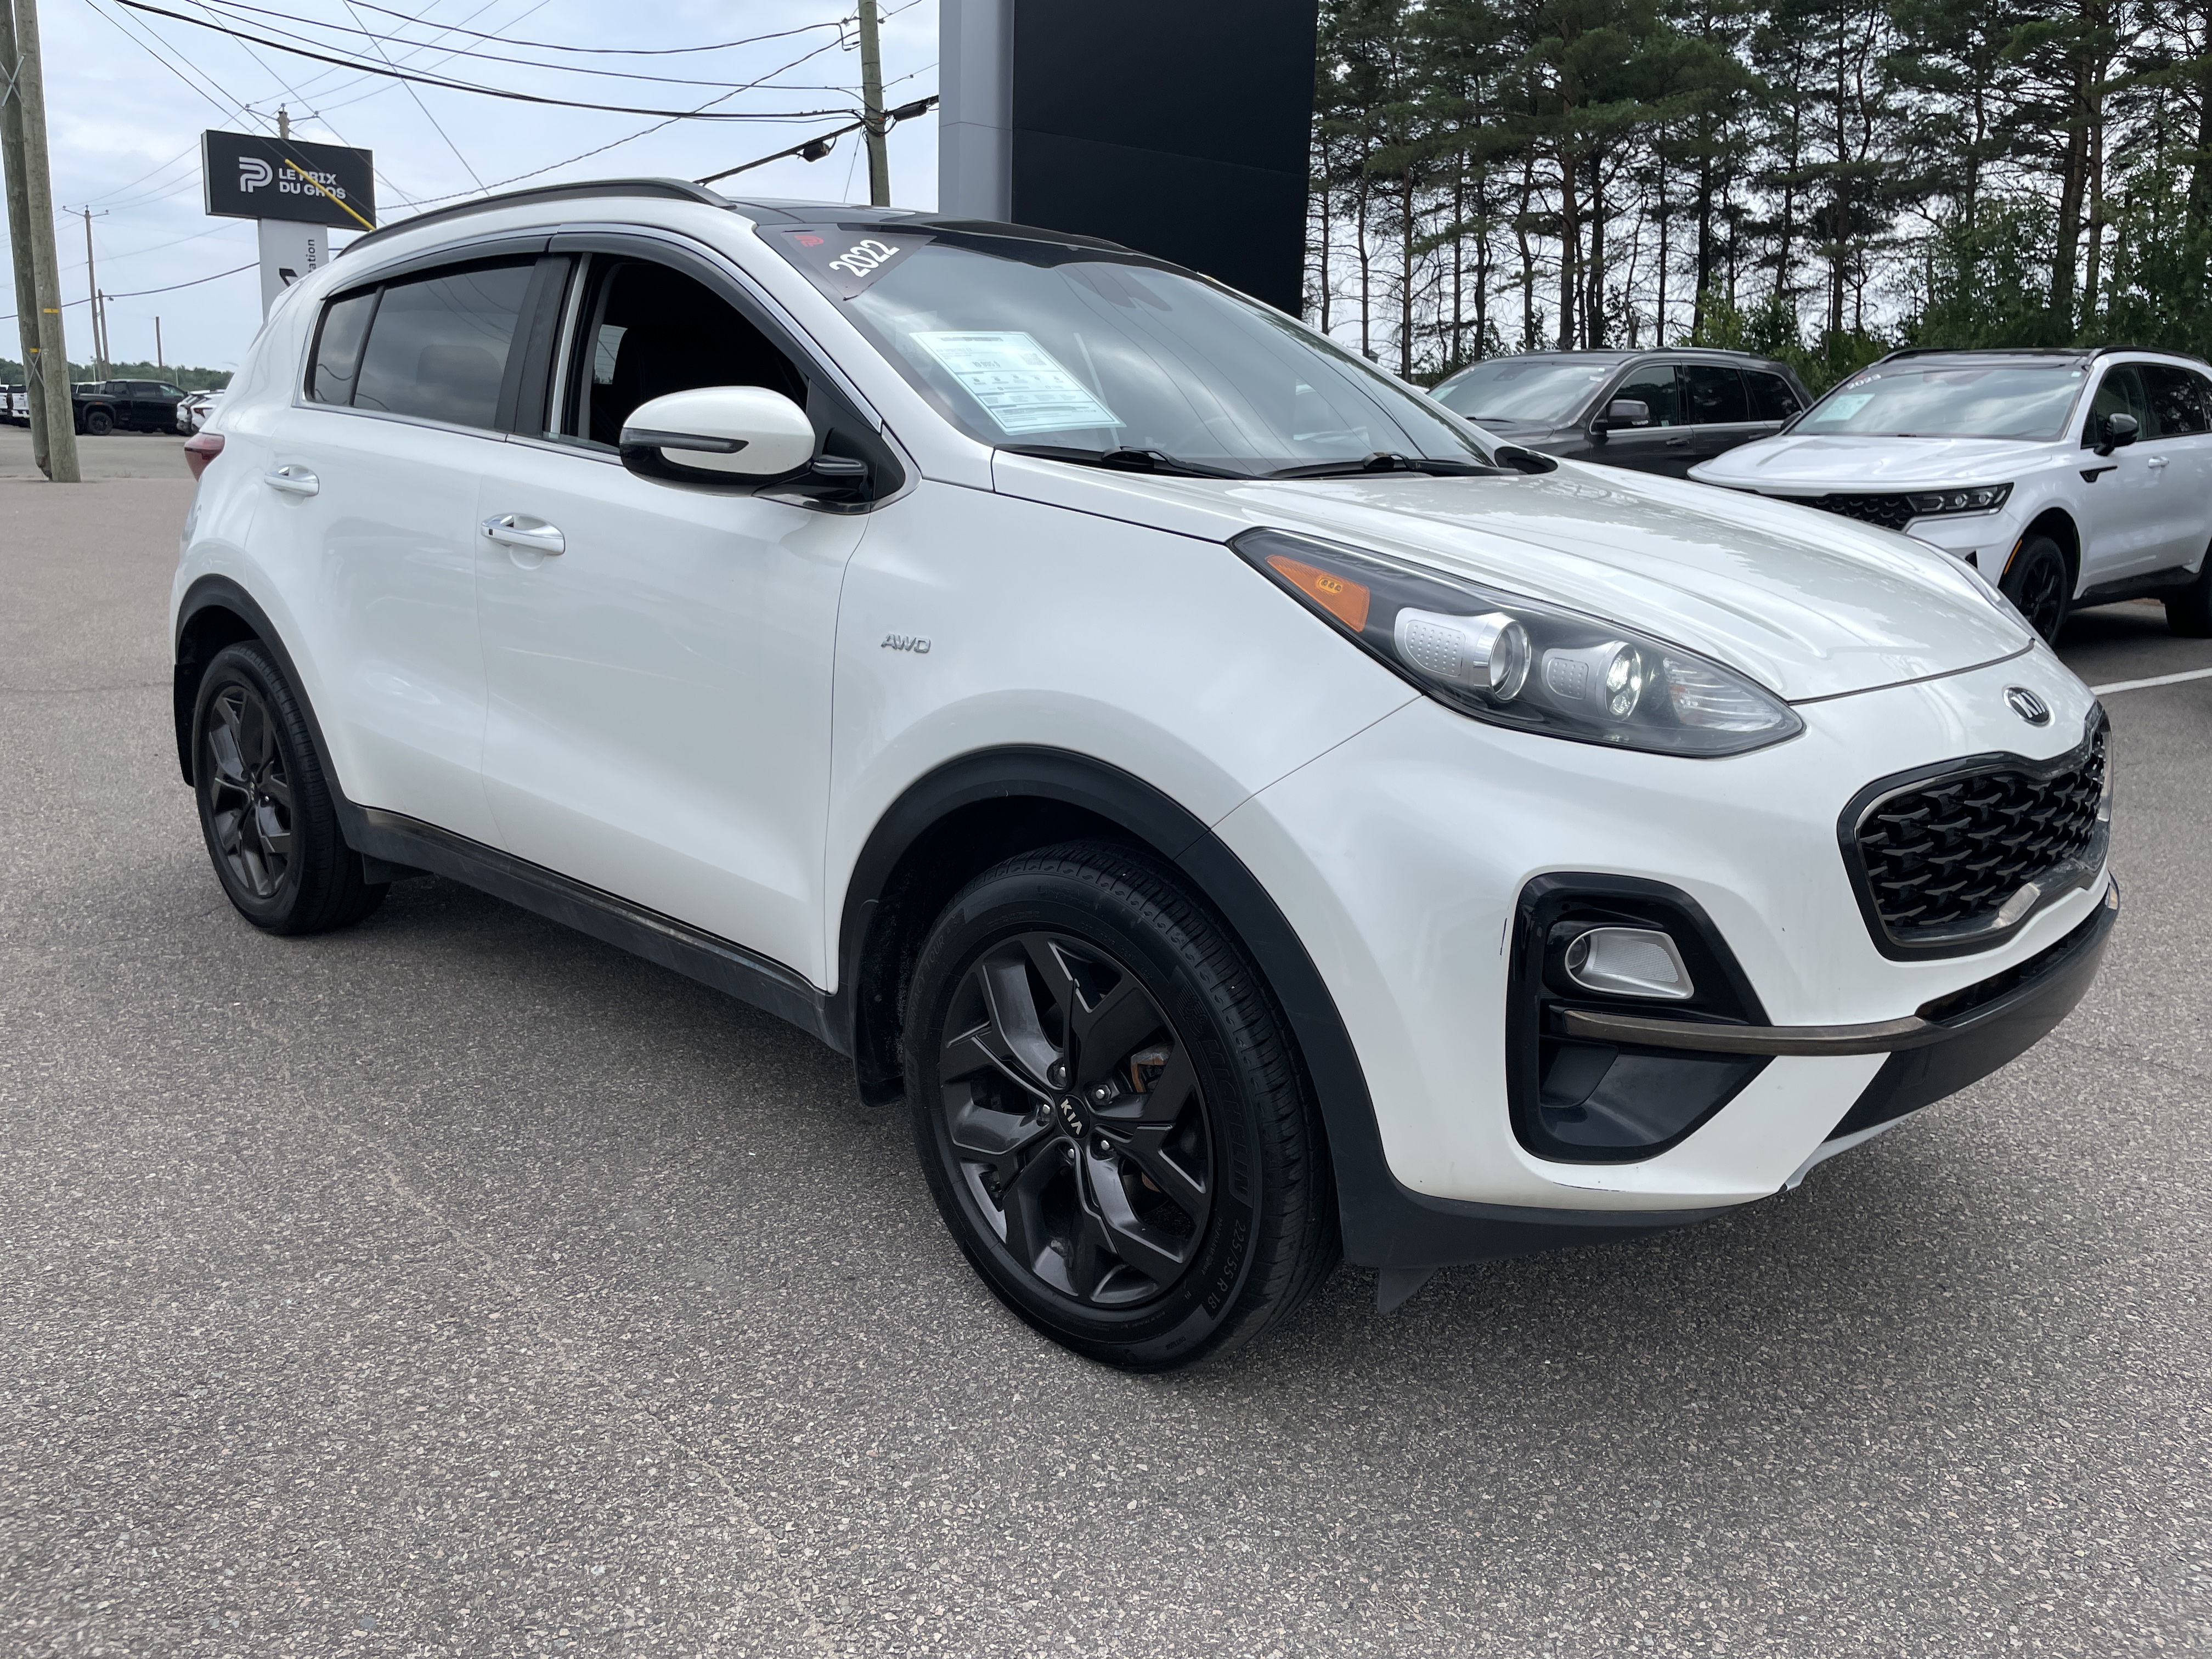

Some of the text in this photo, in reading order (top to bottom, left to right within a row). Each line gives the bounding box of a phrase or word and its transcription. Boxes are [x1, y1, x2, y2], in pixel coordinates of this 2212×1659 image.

[279, 168, 296, 180] LE
[279, 181, 301, 194] DU
[829, 239, 900, 278] 2022
[881, 634, 931, 653] AWD
[1060, 1098, 1082, 1135] KIA
[1207, 1219, 1246, 1309] 225/55 R 18
